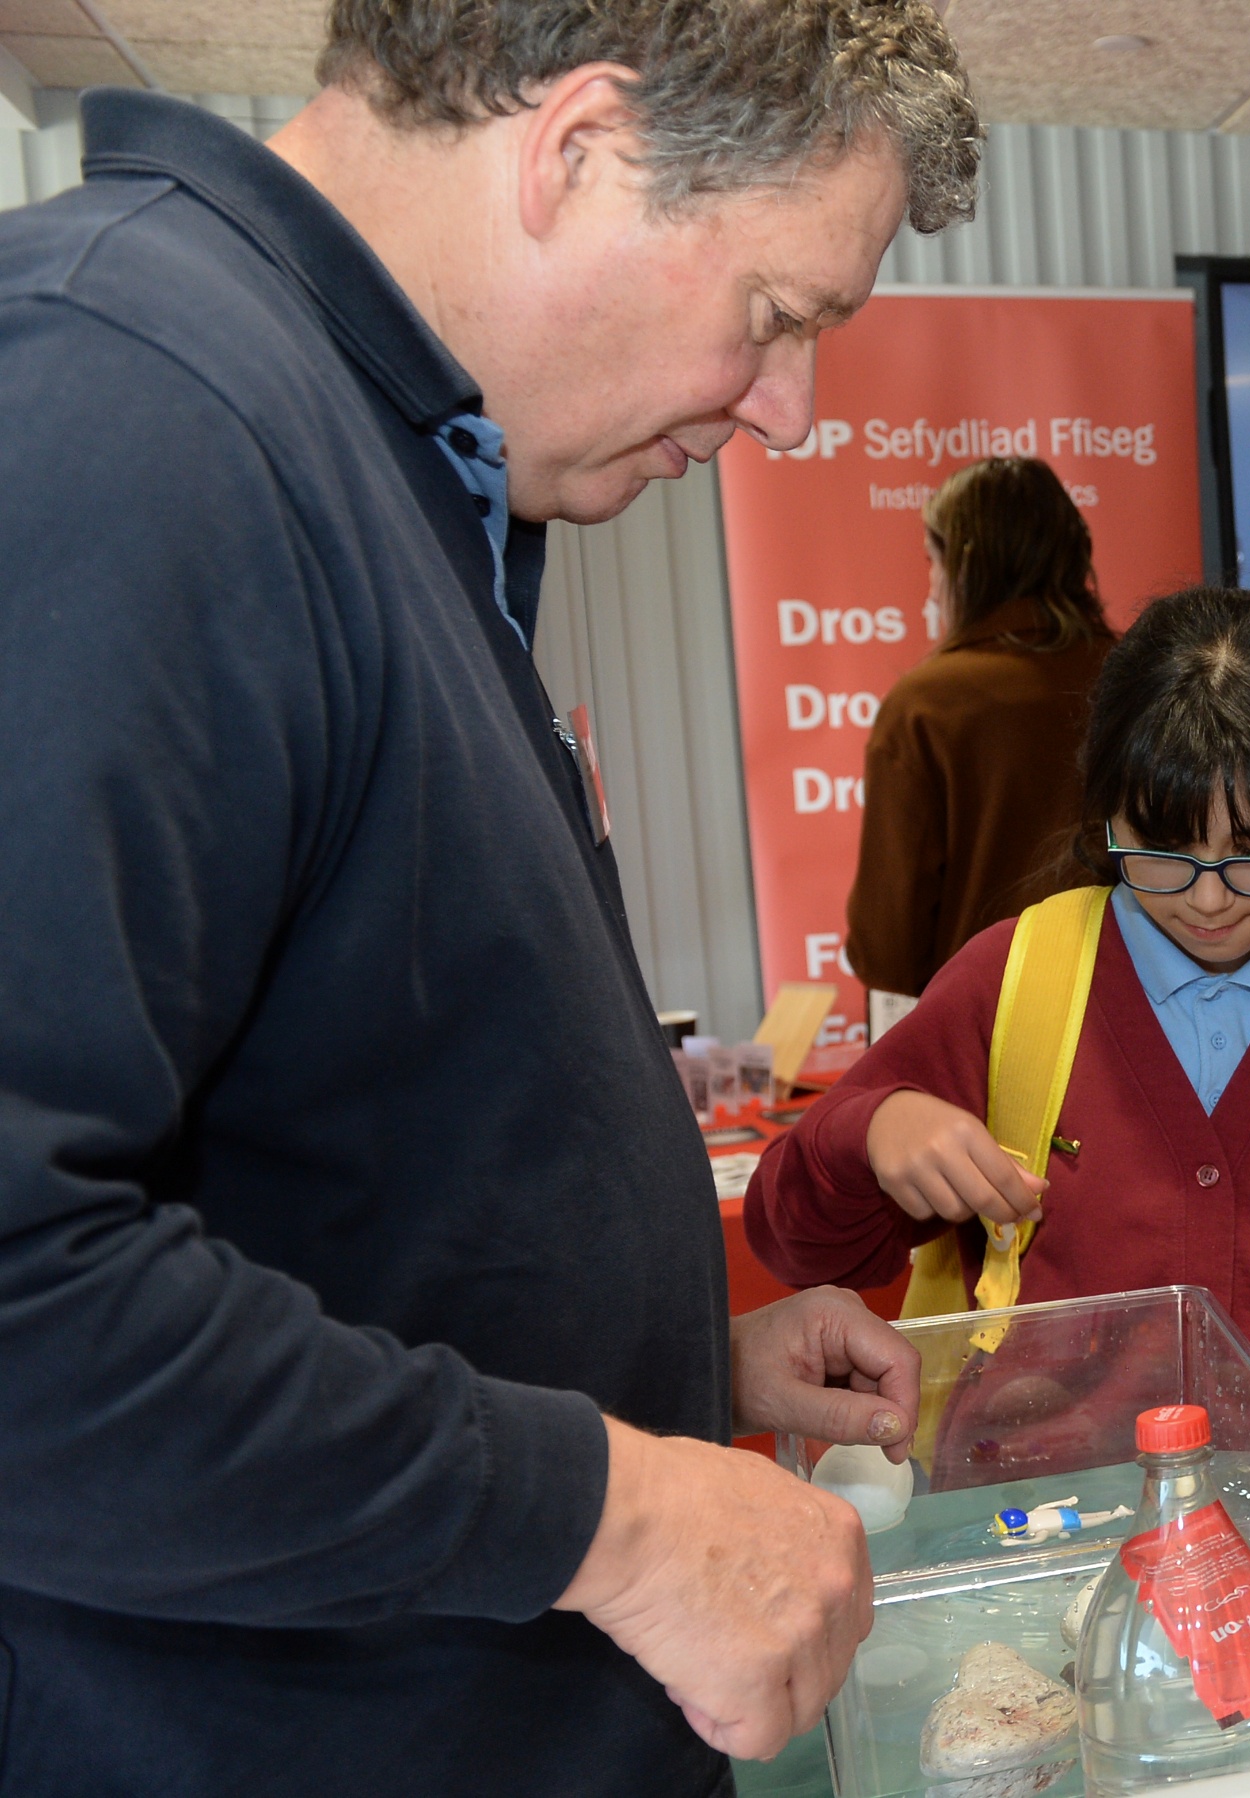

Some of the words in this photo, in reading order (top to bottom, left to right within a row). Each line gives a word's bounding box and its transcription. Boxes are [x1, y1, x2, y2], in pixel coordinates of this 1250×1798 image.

[766, 419, 854, 460] OP
[864, 417, 1037, 467] Sefydliad
[1051, 417, 1157, 465] Ffiseg
[778, 599, 906, 646] Dros
